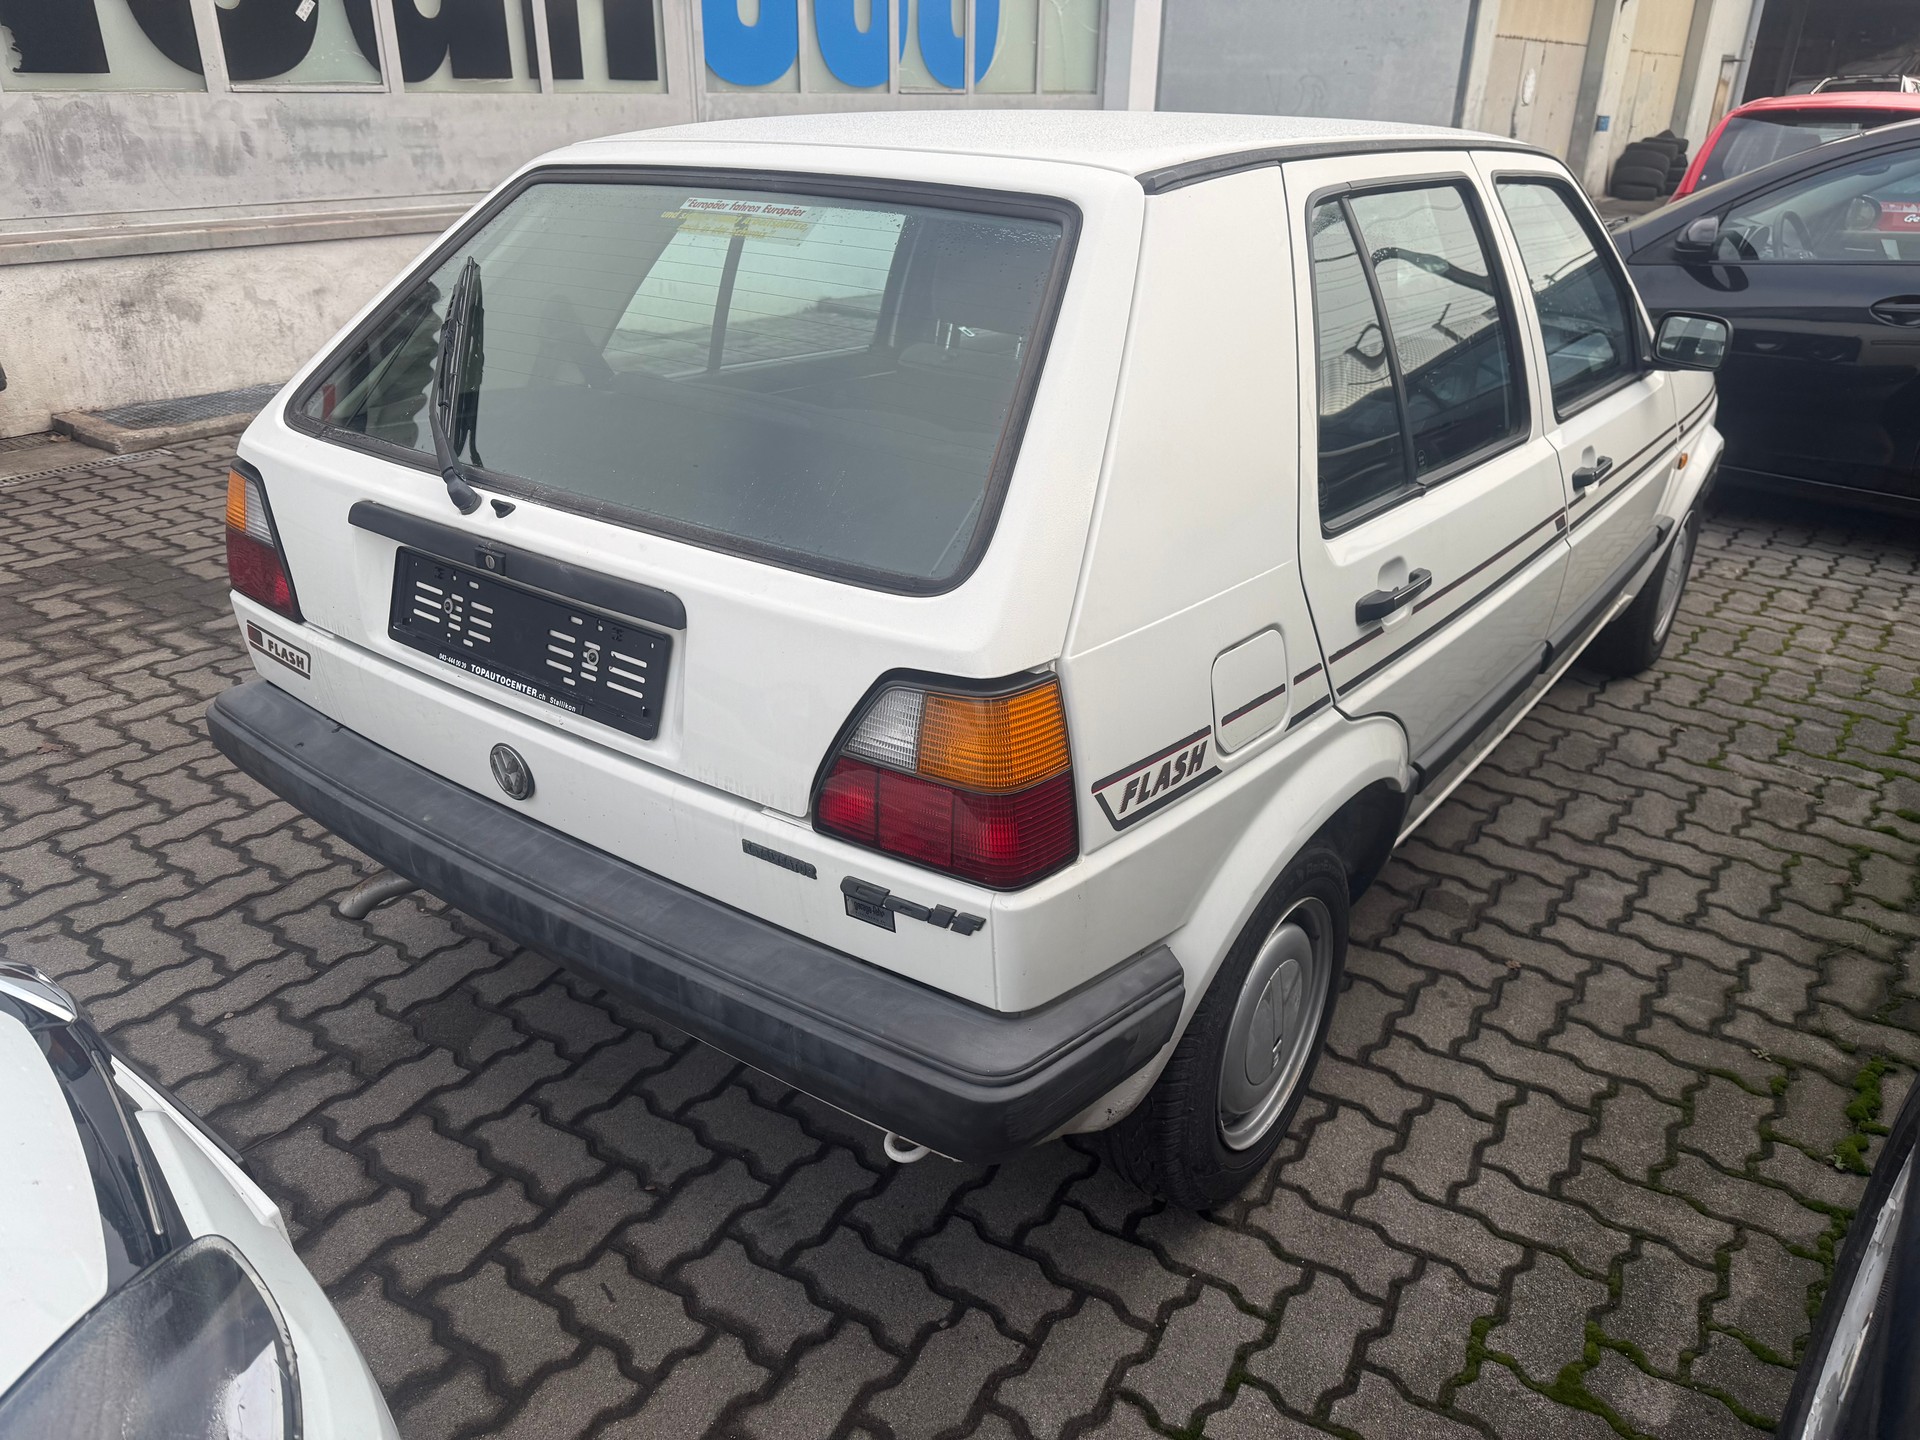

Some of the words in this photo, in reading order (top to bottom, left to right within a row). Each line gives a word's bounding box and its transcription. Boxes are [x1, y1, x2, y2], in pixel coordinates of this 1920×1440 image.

[730, 201, 760, 213] fahren
[763, 204, 807, 217] Europäer
[267, 640, 306, 672] FLASH
[549, 696, 577, 713] Stallikon
[1119, 740, 1208, 814] FLASH
